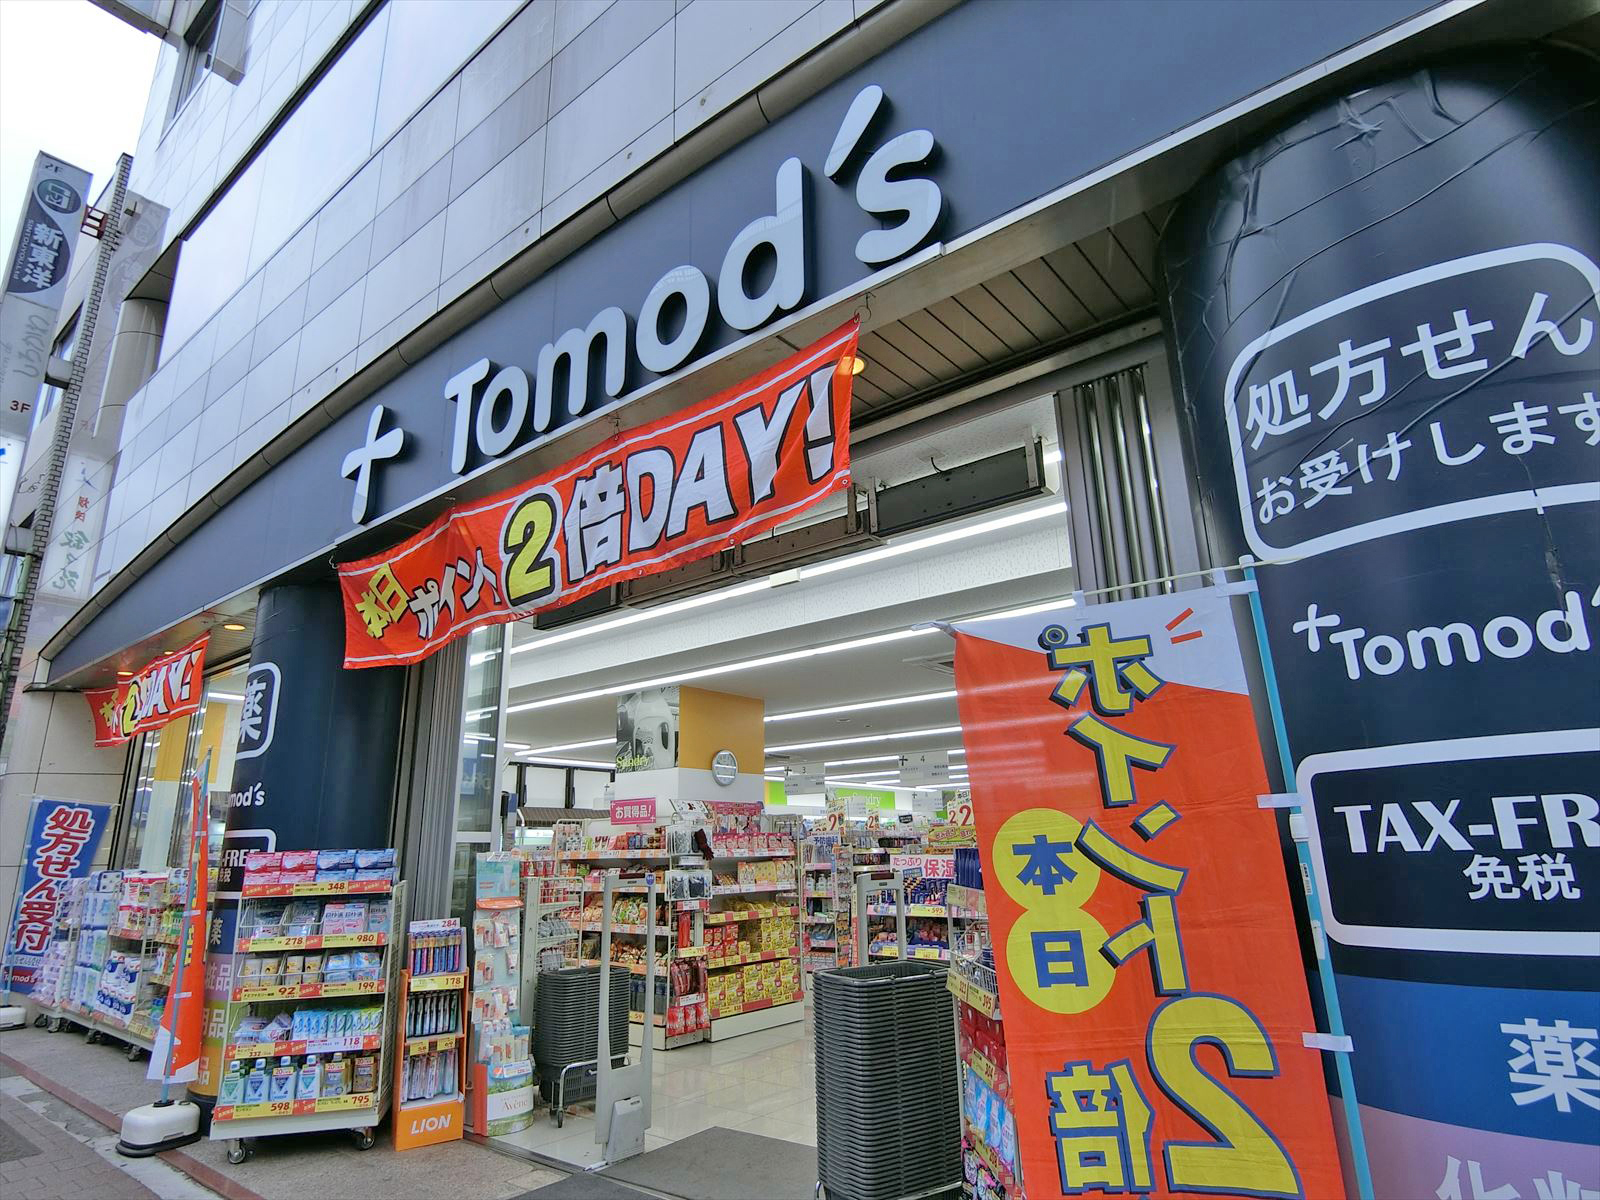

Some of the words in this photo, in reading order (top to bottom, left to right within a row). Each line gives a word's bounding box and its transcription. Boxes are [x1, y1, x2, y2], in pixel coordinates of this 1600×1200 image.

[22, 222, 64, 289] 新東洋
[445, 84, 948, 476] Tomod's
[1245, 292, 1595, 450] 処方せん
[10, 400, 31, 413] 3F
[1256, 392, 1600, 524] お受けします
[615, 804, 651, 819] お買得品!
[893, 856, 922, 867] たっぷり
[923, 858, 954, 878] 保湿
[16, 807, 92, 953] 処方せん受付
[1462, 852, 1581, 902] 免税
[327, 882, 345, 891] 348
[442, 919, 457, 928] 284
[284, 937, 303, 946] 278
[355, 934, 375, 944] 980
[278, 986, 296, 996] 92
[358, 981, 375, 991] 199
[341, 1037, 360, 1046] 118
[1499, 1017, 1600, 1113] 薬
[351, 1095, 369, 1104] 795
[270, 1102, 290, 1111] 598
[410, 1109, 452, 1134] LION
